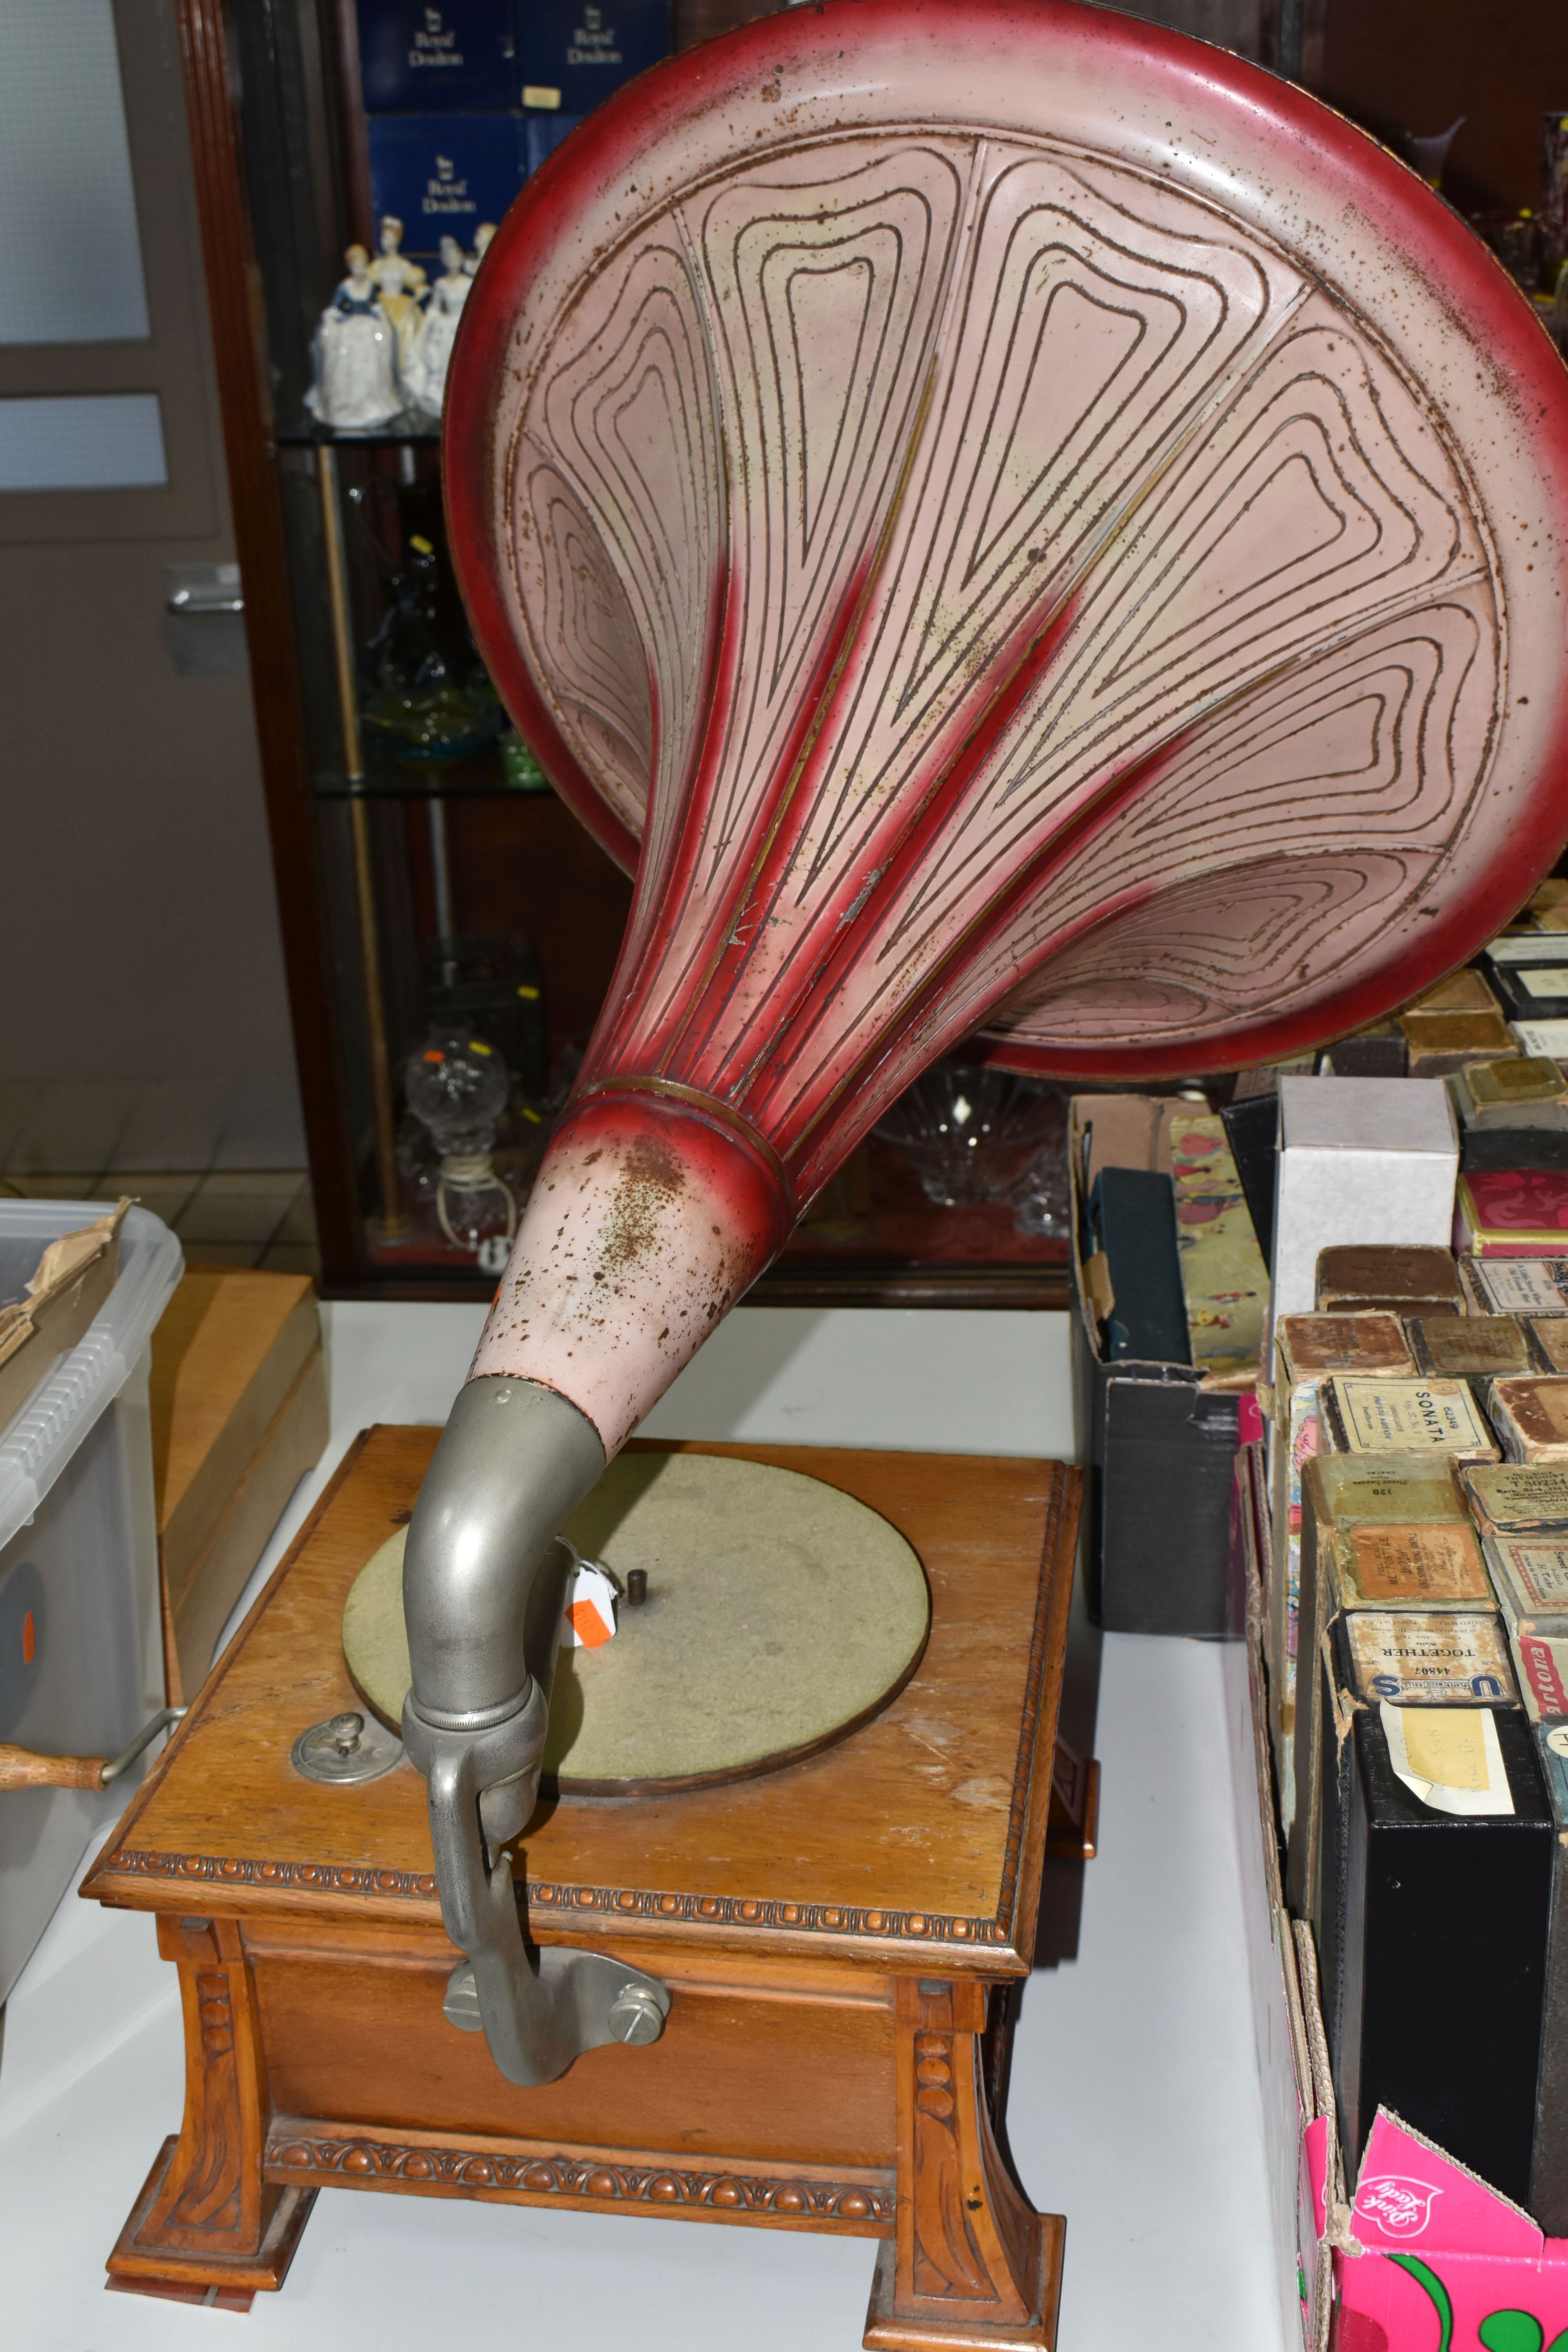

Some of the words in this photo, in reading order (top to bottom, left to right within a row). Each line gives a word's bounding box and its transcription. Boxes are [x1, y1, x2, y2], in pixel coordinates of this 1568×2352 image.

[408, 48, 463, 67] Doulton
[567, 46, 622, 65] Doulton
[422, 197, 476, 214] Doulton
[1363, 1406, 1373, 1429] Beethoven
[1373, 1396, 1385, 1416] PRESTO
[1380, 1417, 1392, 1439] AGITATO
[1416, 1392, 1445, 1442] SONATA
[1443, 1407, 1459, 1429] 62349
[1377, 1562, 1385, 1576] FULL
[1554, 1551, 1568, 1569] Sweet
[1542, 1572, 1554, 1589] Tucker
[1374, 2181, 1426, 2212] Lady
[1361, 2195, 1419, 2227] Pink
